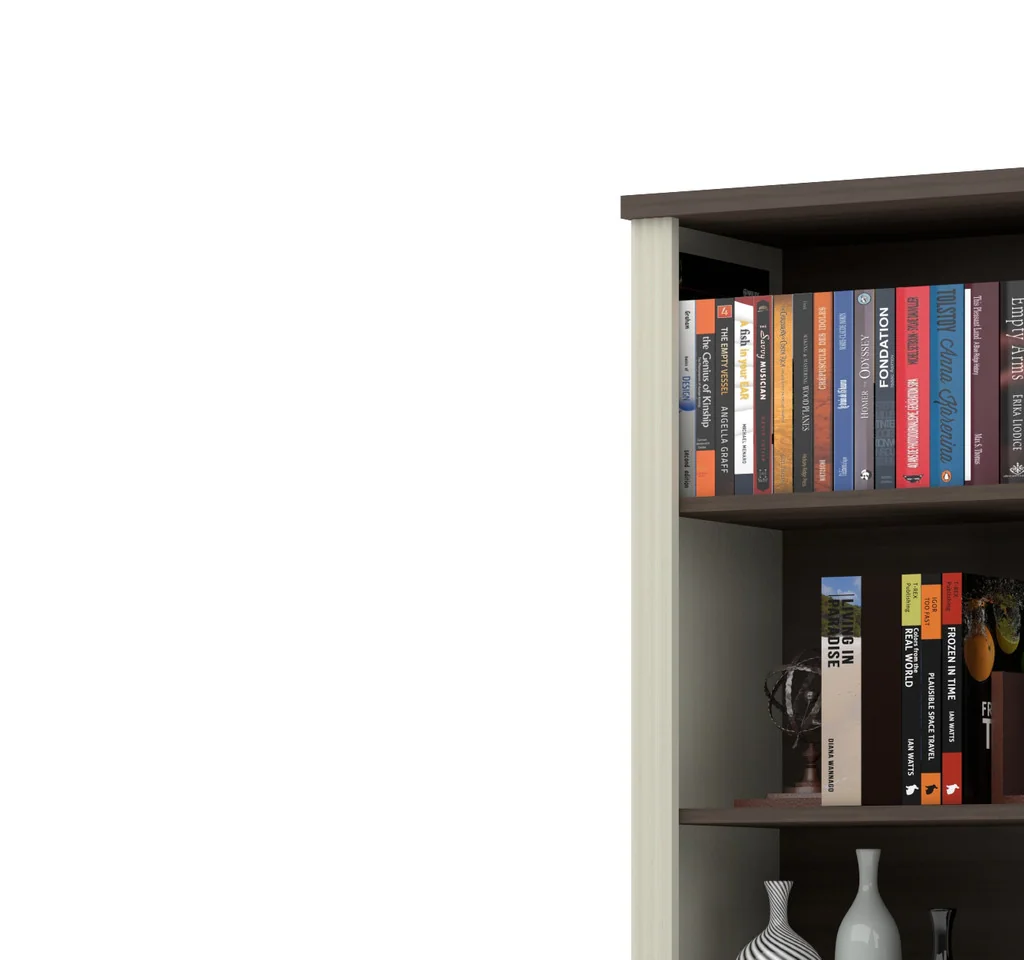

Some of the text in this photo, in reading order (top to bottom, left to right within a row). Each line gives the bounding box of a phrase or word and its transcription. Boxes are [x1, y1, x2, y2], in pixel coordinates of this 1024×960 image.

[721, 307, 728, 316] 4
[973, 295, 982, 307] This
[702, 336, 712, 350] the
[740, 329, 750, 346] fish
[740, 348, 749, 357] in
[756, 330, 770, 360] Savvy
[817, 306, 827, 390] CRÉPUSCULE DES IDOLES
[879, 307, 889, 388] FONDATION
[702, 352, 712, 382] Genius
[720, 327, 728, 396] THE EMPTY VESSEL
[738, 359, 747, 379] your
[858, 334, 871, 379] ODYSSEY
[702, 384, 712, 393] of
[740, 381, 749, 400] EAR
[933, 288, 958, 464] TOLSTOY Anna Karenina
[701, 396, 712, 428] Kinship
[860, 391, 868, 419] HOMER
[1012, 394, 1023, 451] ERIKA LIODICE
[720, 406, 728, 474] ANGELLA GRAFF
[828, 599, 840, 668] PARADISE
[841, 599, 854, 665] LIVING IN
[904, 628, 913, 688] REAL WORLD
[947, 626, 956, 701] FROZEN IN TIME
[982, 718, 992, 750] T
[907, 738, 915, 777] IAN WATTS
